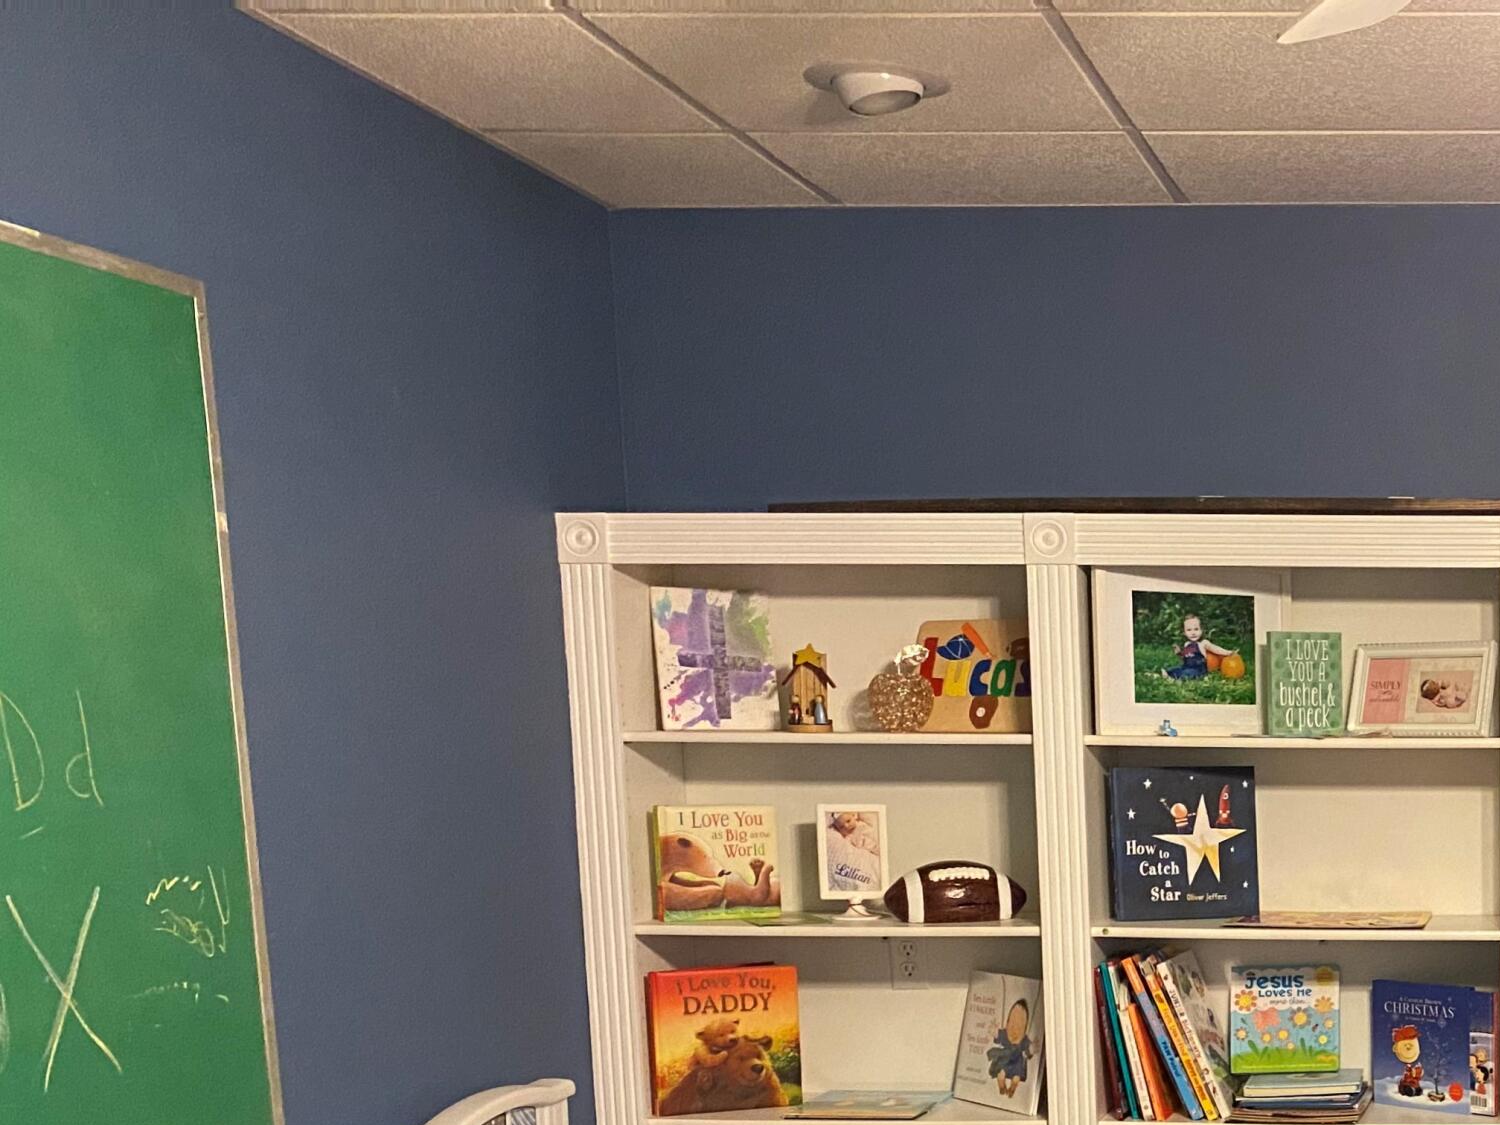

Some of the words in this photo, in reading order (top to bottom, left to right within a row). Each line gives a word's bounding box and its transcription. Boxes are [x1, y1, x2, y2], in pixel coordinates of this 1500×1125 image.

[1286, 639, 1291, 660] I
[1296, 639, 1328, 660] LOVE
[1288, 661, 1314, 682] YOU
[1318, 661, 1326, 682] A
[1280, 681, 1322, 707] bushel
[1285, 707, 1294, 728] a
[1298, 703, 1331, 732] peck
[678, 811, 684, 826] I
[691, 811, 729, 829] Love
[734, 811, 763, 827] You
[725, 829, 748, 843] Big
[723, 843, 765, 858] World
[1126, 839, 1157, 856] How
[1159, 850, 1170, 859] to
[1139, 860, 1180, 876] Catch
[1164, 880, 1172, 888] a
[1150, 886, 1182, 902] Star
[688, 975, 730, 992] Love
[683, 991, 773, 1016] DADDY
[1383, 1000, 1456, 1019] CHRISTMAS
